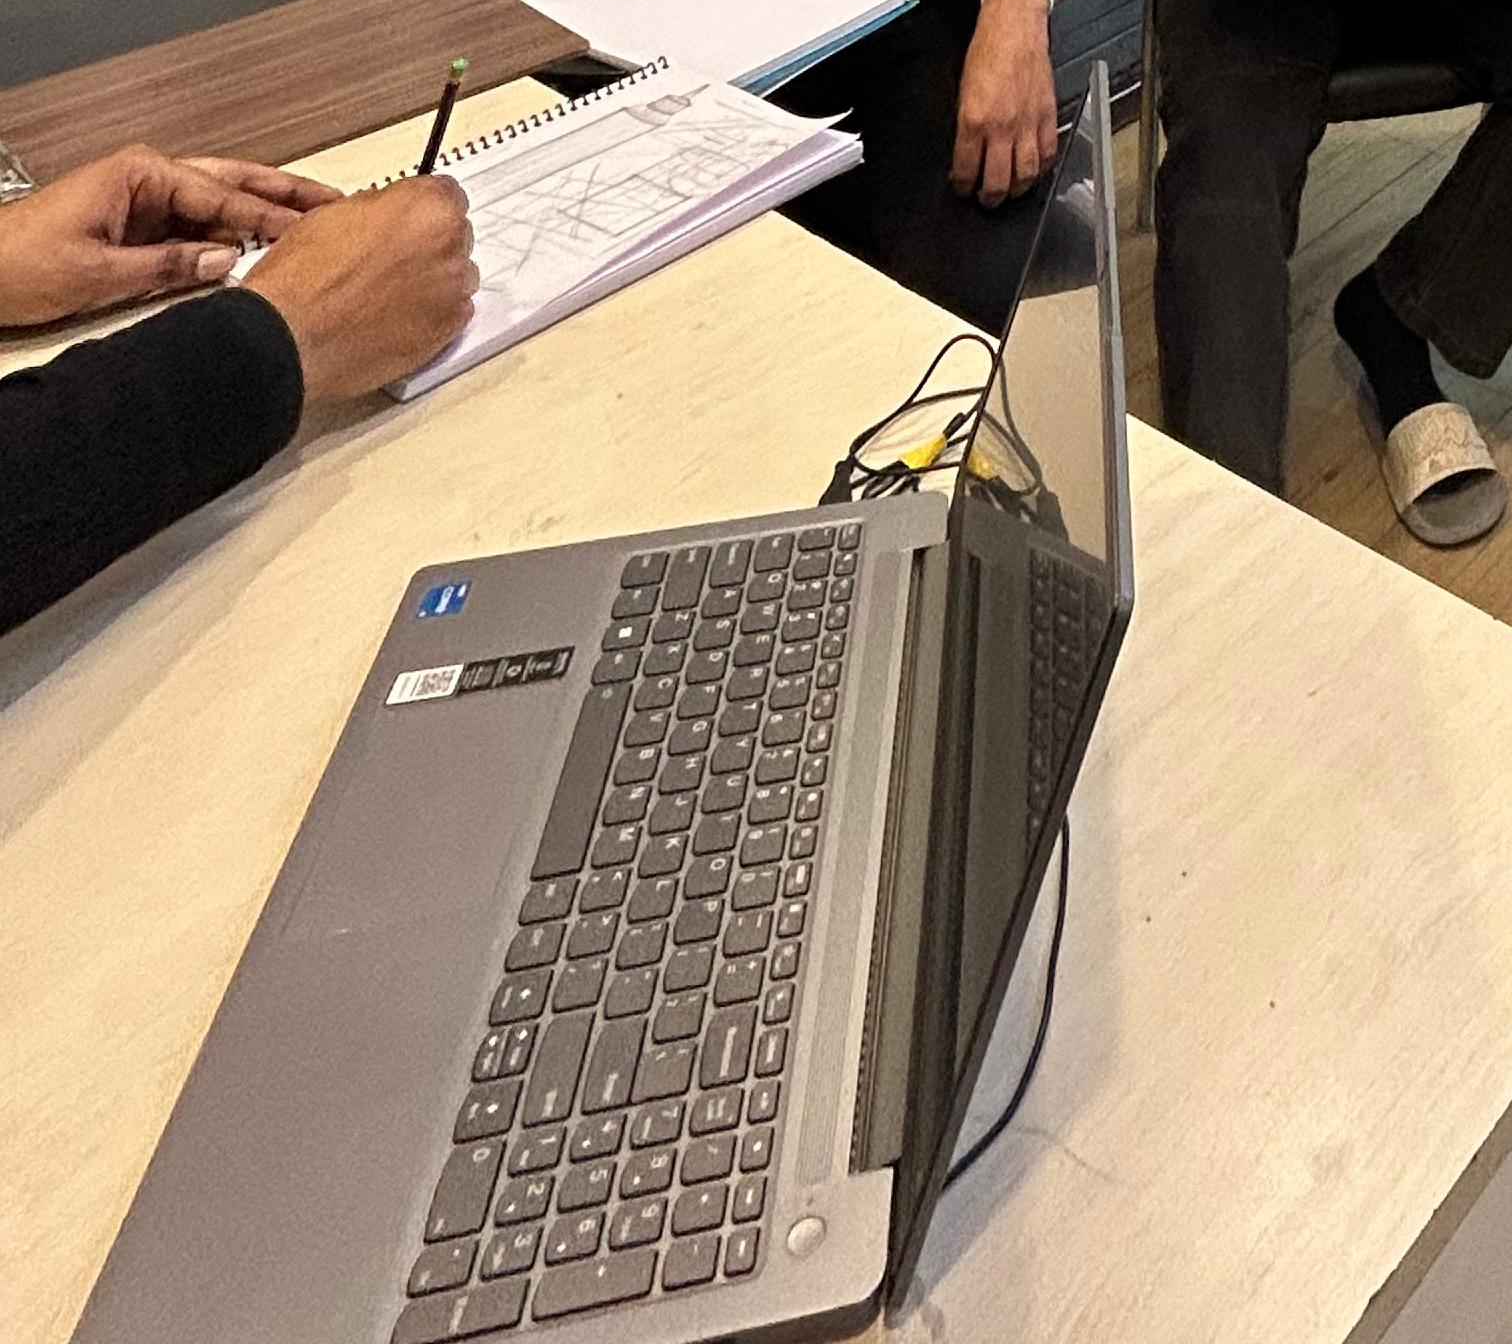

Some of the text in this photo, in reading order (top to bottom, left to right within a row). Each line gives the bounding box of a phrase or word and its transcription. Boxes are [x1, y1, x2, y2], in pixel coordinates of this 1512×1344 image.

[756, 635, 770, 643] E
[658, 678, 673, 689] C
[666, 837, 680, 849] K
[656, 880, 669, 891] L
